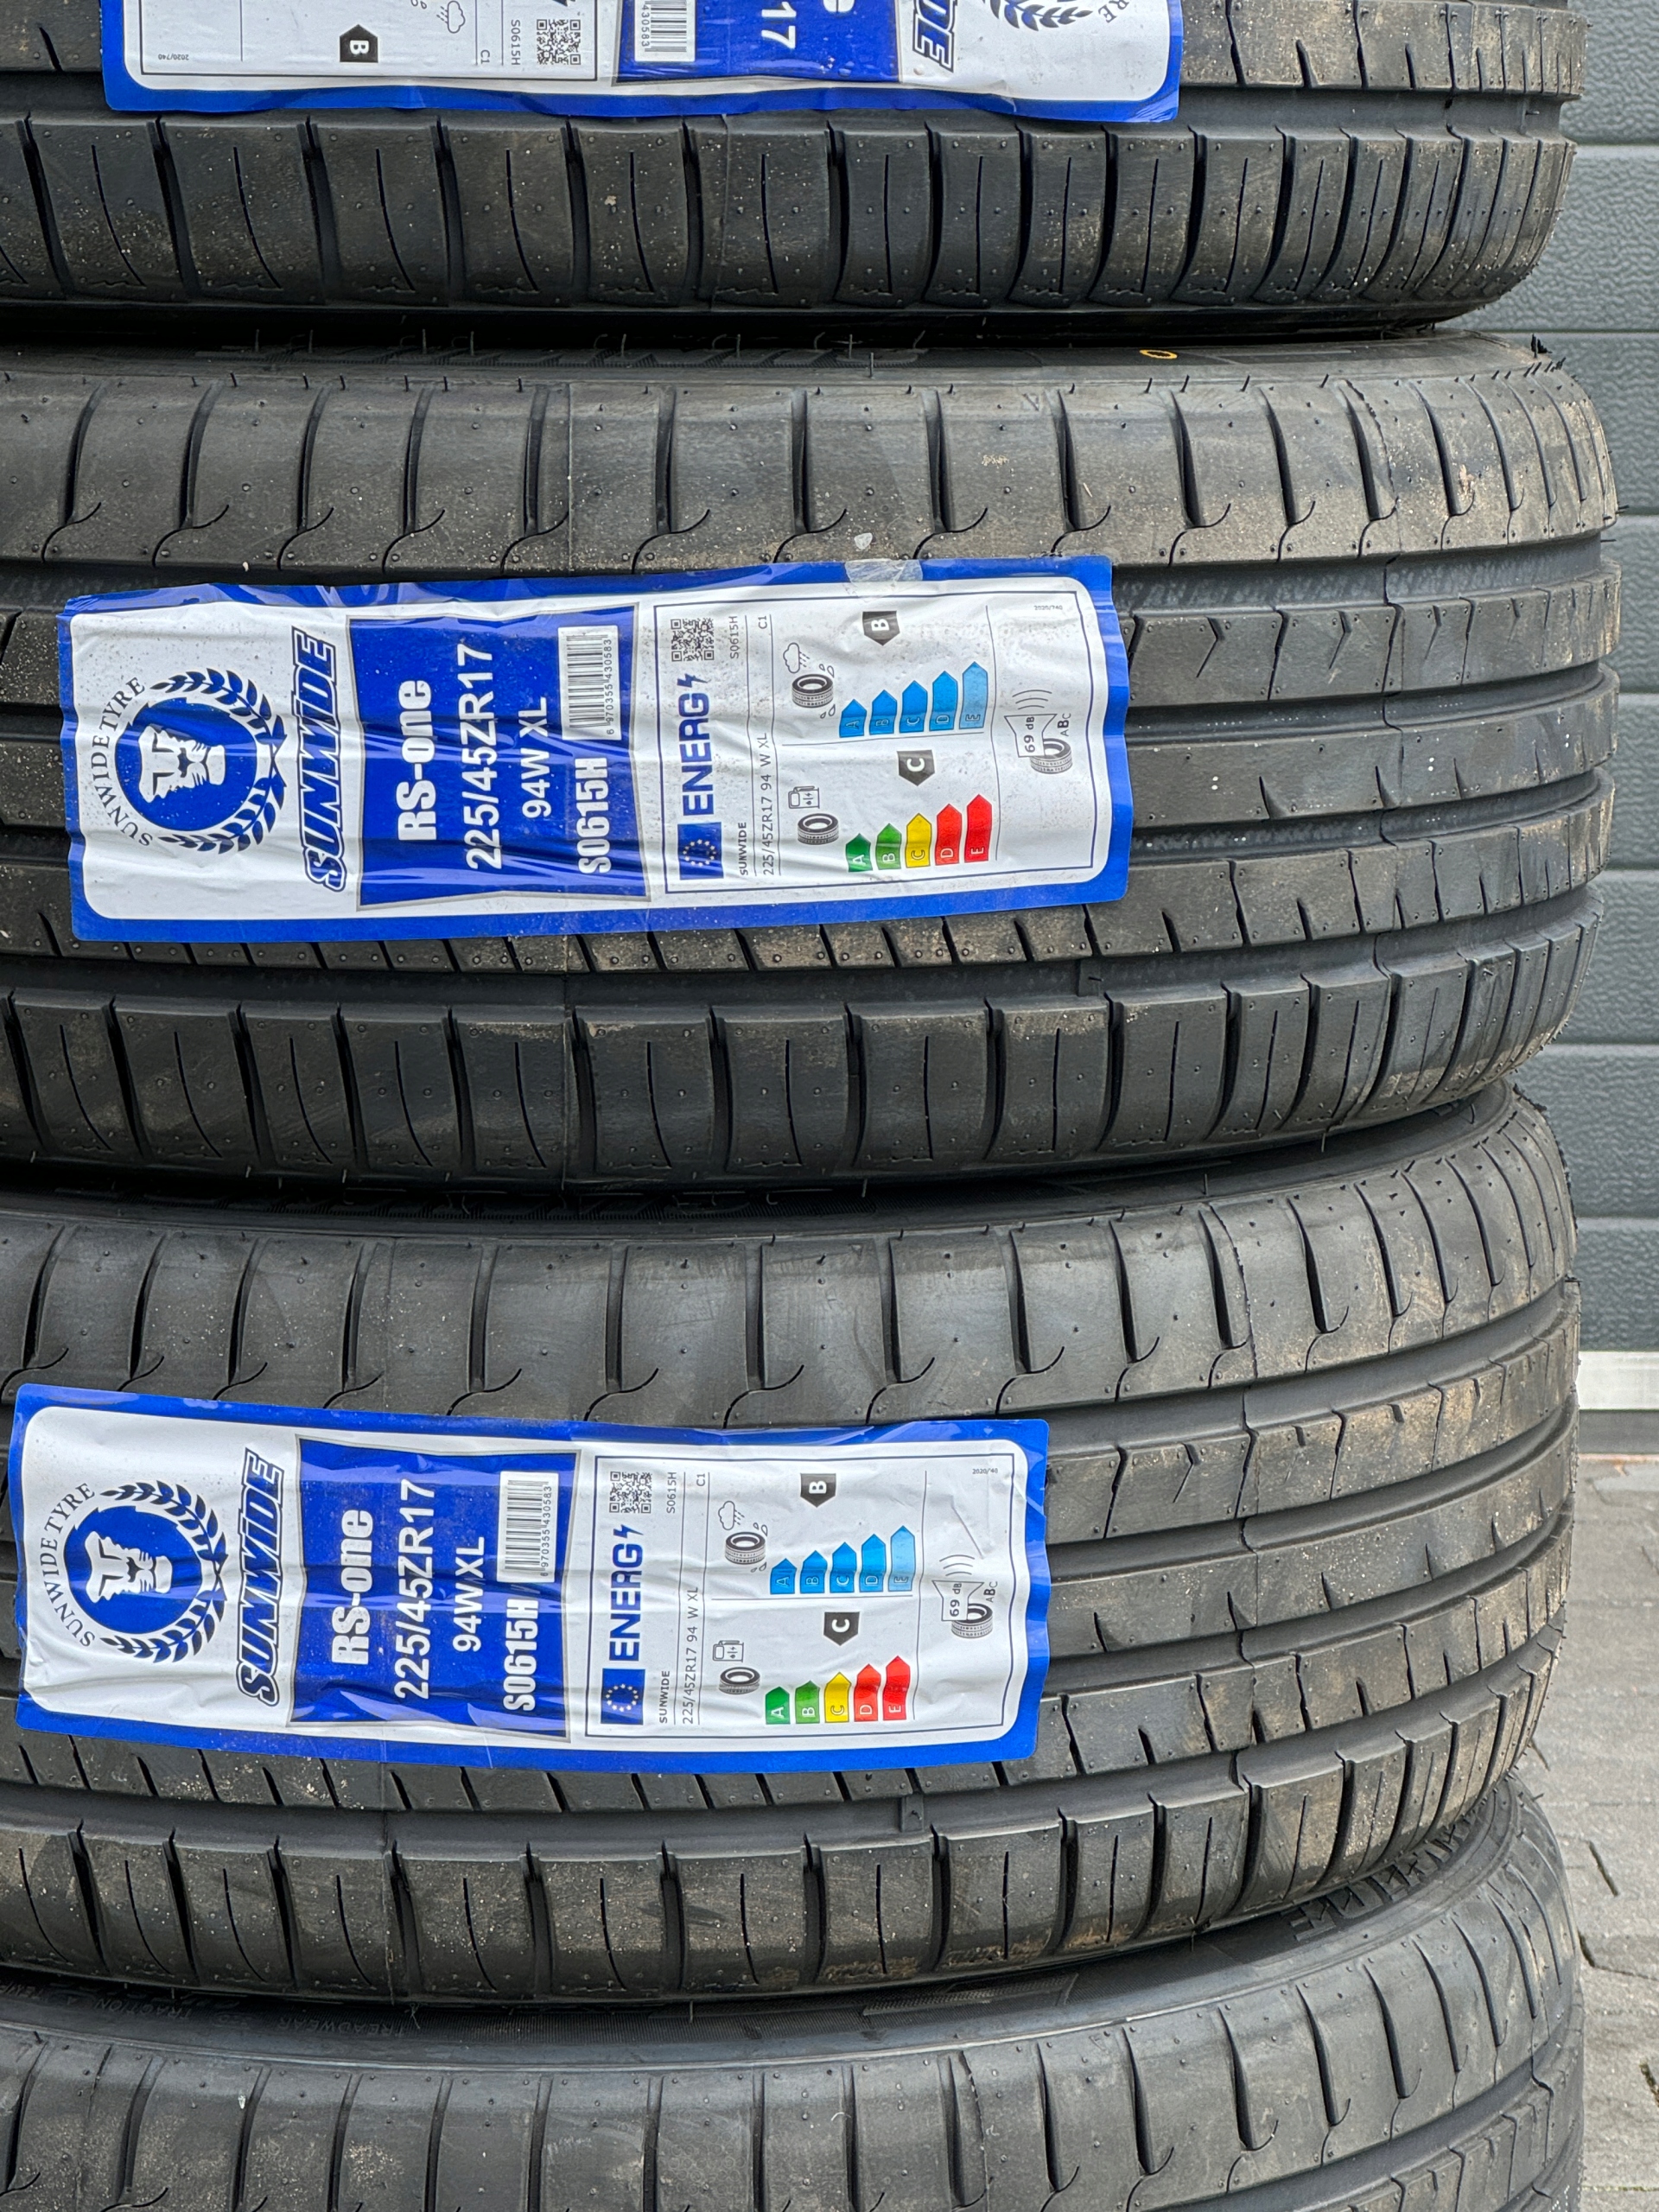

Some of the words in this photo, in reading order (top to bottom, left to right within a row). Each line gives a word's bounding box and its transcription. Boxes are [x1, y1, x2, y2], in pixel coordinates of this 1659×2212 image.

[349, 40, 369, 55] B
[511, 19, 521, 66] S0615H
[480, 49, 491, 65] C1
[758, 615, 768, 630] C1
[871, 618, 890, 632] B
[728, 615, 740, 659] S0615H
[99, 677, 146, 733] TYRE
[518, 696, 549, 738] XL
[846, 720, 860, 730] A
[875, 718, 890, 727] B
[907, 716, 920, 725] C
[935, 715, 950, 725] D
[1025, 716, 1035, 730] dB
[757, 732, 770, 749] XL
[1023, 734, 1036, 753] 69
[291, 626, 347, 892] SUNWIDE
[396, 679, 437, 841] RS-one
[457, 643, 502, 870] 225/45ZR17
[760, 753, 772, 768] W
[906, 757, 925, 772] C
[91, 734, 154, 847] SUNWIDE
[520, 747, 552, 818] 94W
[760, 773, 773, 791] 94
[575, 757, 611, 874] S0615H
[760, 797, 775, 875] 225/45ZR17
[737, 822, 749, 876] SUNWIDE
[852, 854, 867, 865] A
[881, 852, 896, 863] B
[910, 849, 925, 861] C
[940, 848, 954, 859] D
[696, 1472, 706, 1487] C1
[808, 1480, 827, 1495] B
[666, 1471, 677, 1514] S0615H
[45, 1483, 94, 1535] TYRE
[236, 1447, 284, 1707] SUNWIDE
[776, 1576, 790, 1587] A
[805, 1576, 819, 1586] B
[836, 1576, 849, 1586] C
[865, 1575, 879, 1586] D
[40, 1536, 95, 1647] SUNWIDE
[331, 1510, 373, 1665] RS-one
[394, 1478, 435, 1700] 225/45ZR17
[687, 1587, 699, 1604] XL
[952, 1582, 962, 1594] dB
[687, 1606, 699, 1619] W
[950, 1599, 960, 1617] 69
[686, 1626, 698, 1642] 94
[831, 1618, 850, 1633] C
[503, 1599, 539, 1712] S0615H
[683, 1648, 697, 1725] 225/45ZR17
[659, 1670, 671, 1725] SUNWIDE
[771, 1707, 785, 1718] A
[802, 1707, 816, 1718] B
[830, 1705, 845, 1716] C
[859, 1704, 873, 1715] D
[888, 1704, 902, 1713] E
